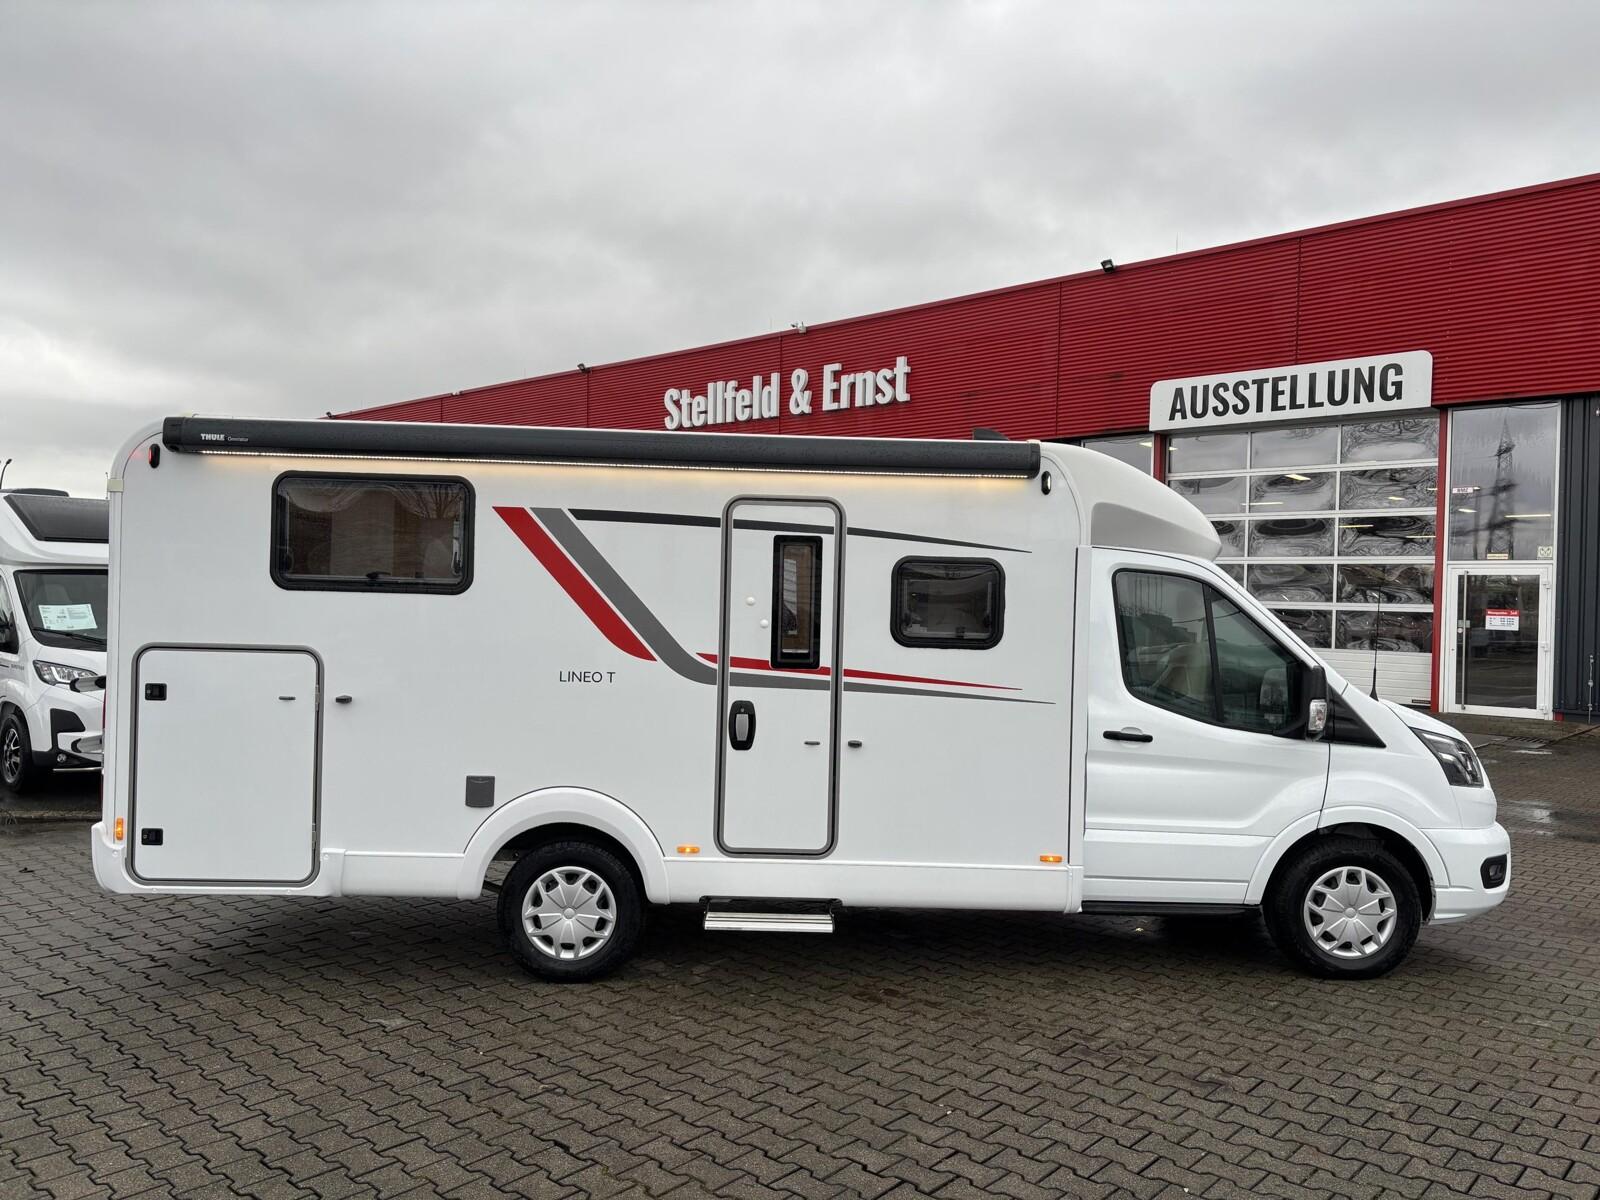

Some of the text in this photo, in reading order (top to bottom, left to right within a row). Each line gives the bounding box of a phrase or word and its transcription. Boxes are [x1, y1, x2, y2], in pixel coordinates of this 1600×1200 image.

[664, 356, 911, 430] Stellfeld & Ernst
[1168, 363, 1404, 421] AUSSTELLUNG
[200, 433, 225, 441] THULE
[559, 671, 616, 683] LINEO T
